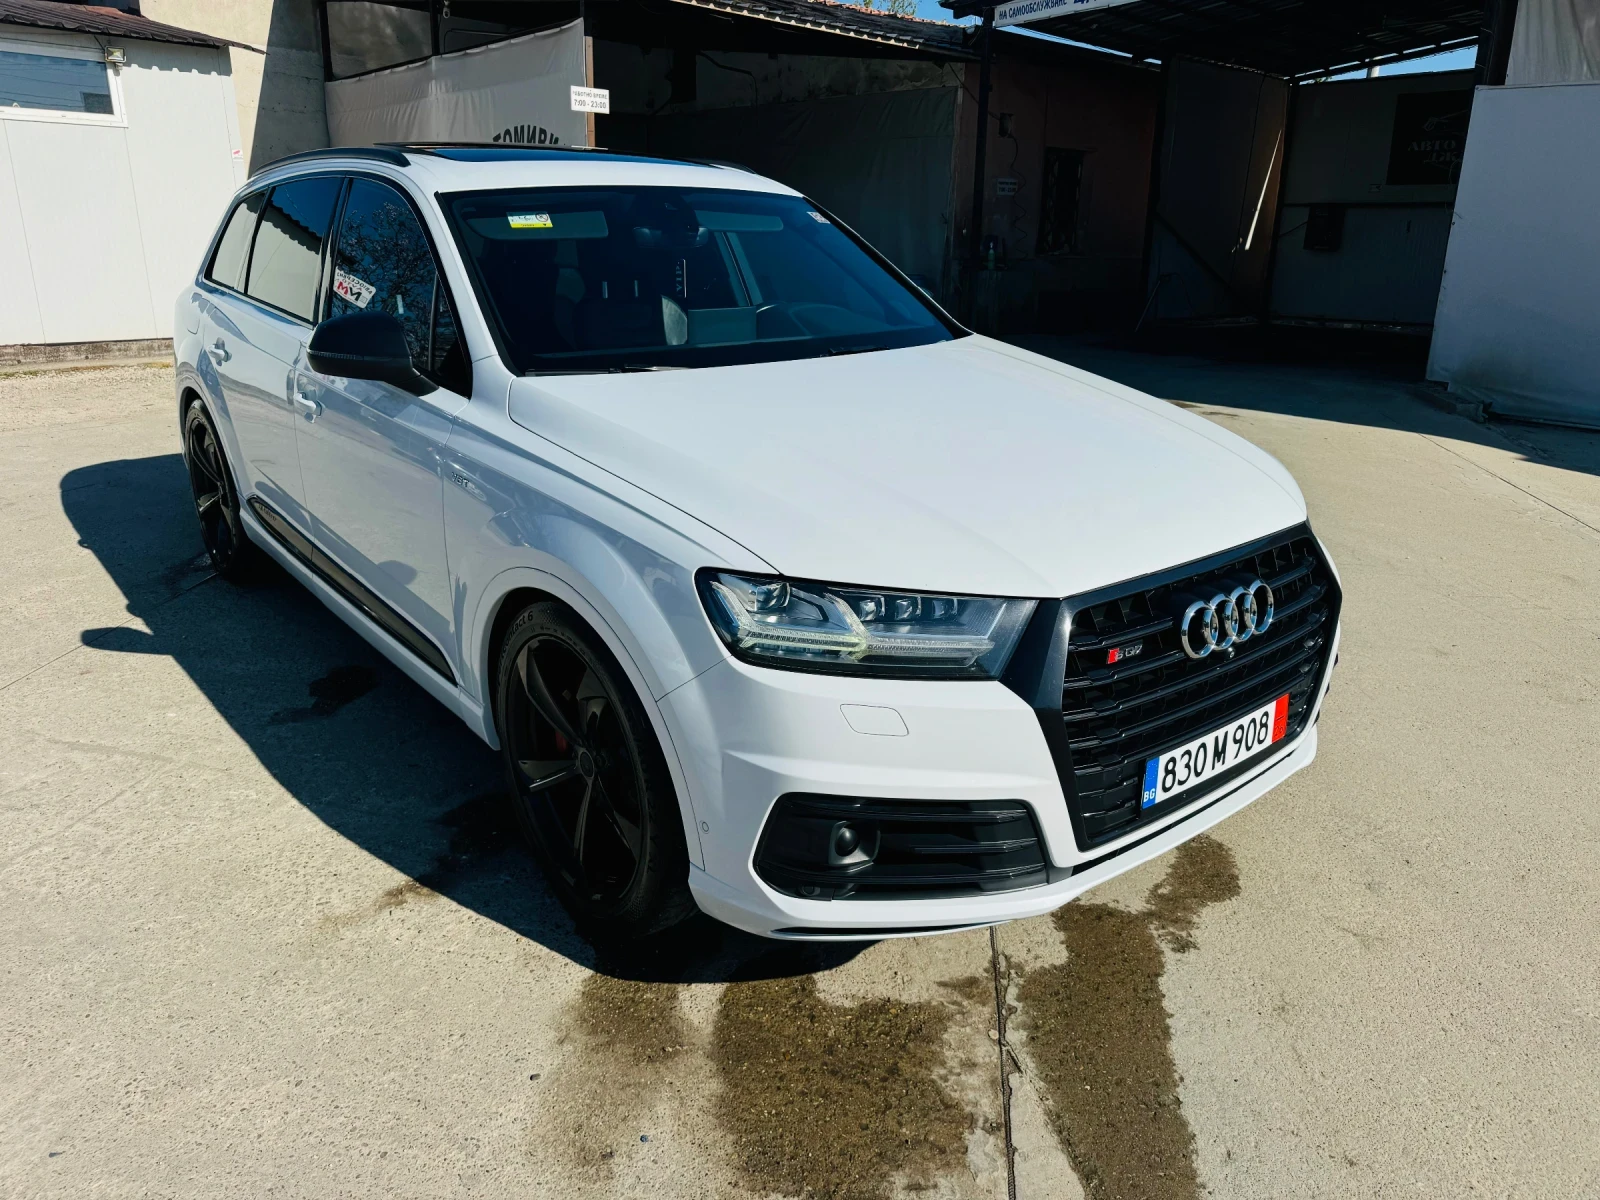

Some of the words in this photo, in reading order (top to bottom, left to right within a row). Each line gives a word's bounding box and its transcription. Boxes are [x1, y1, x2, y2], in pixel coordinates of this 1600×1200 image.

[998, 9, 1008, 20] НА
[1161, 741, 1208, 793] 830
[1211, 730, 1229, 771] M
[1232, 710, 1270, 760] 908
[1143, 788, 1156, 802] BG
